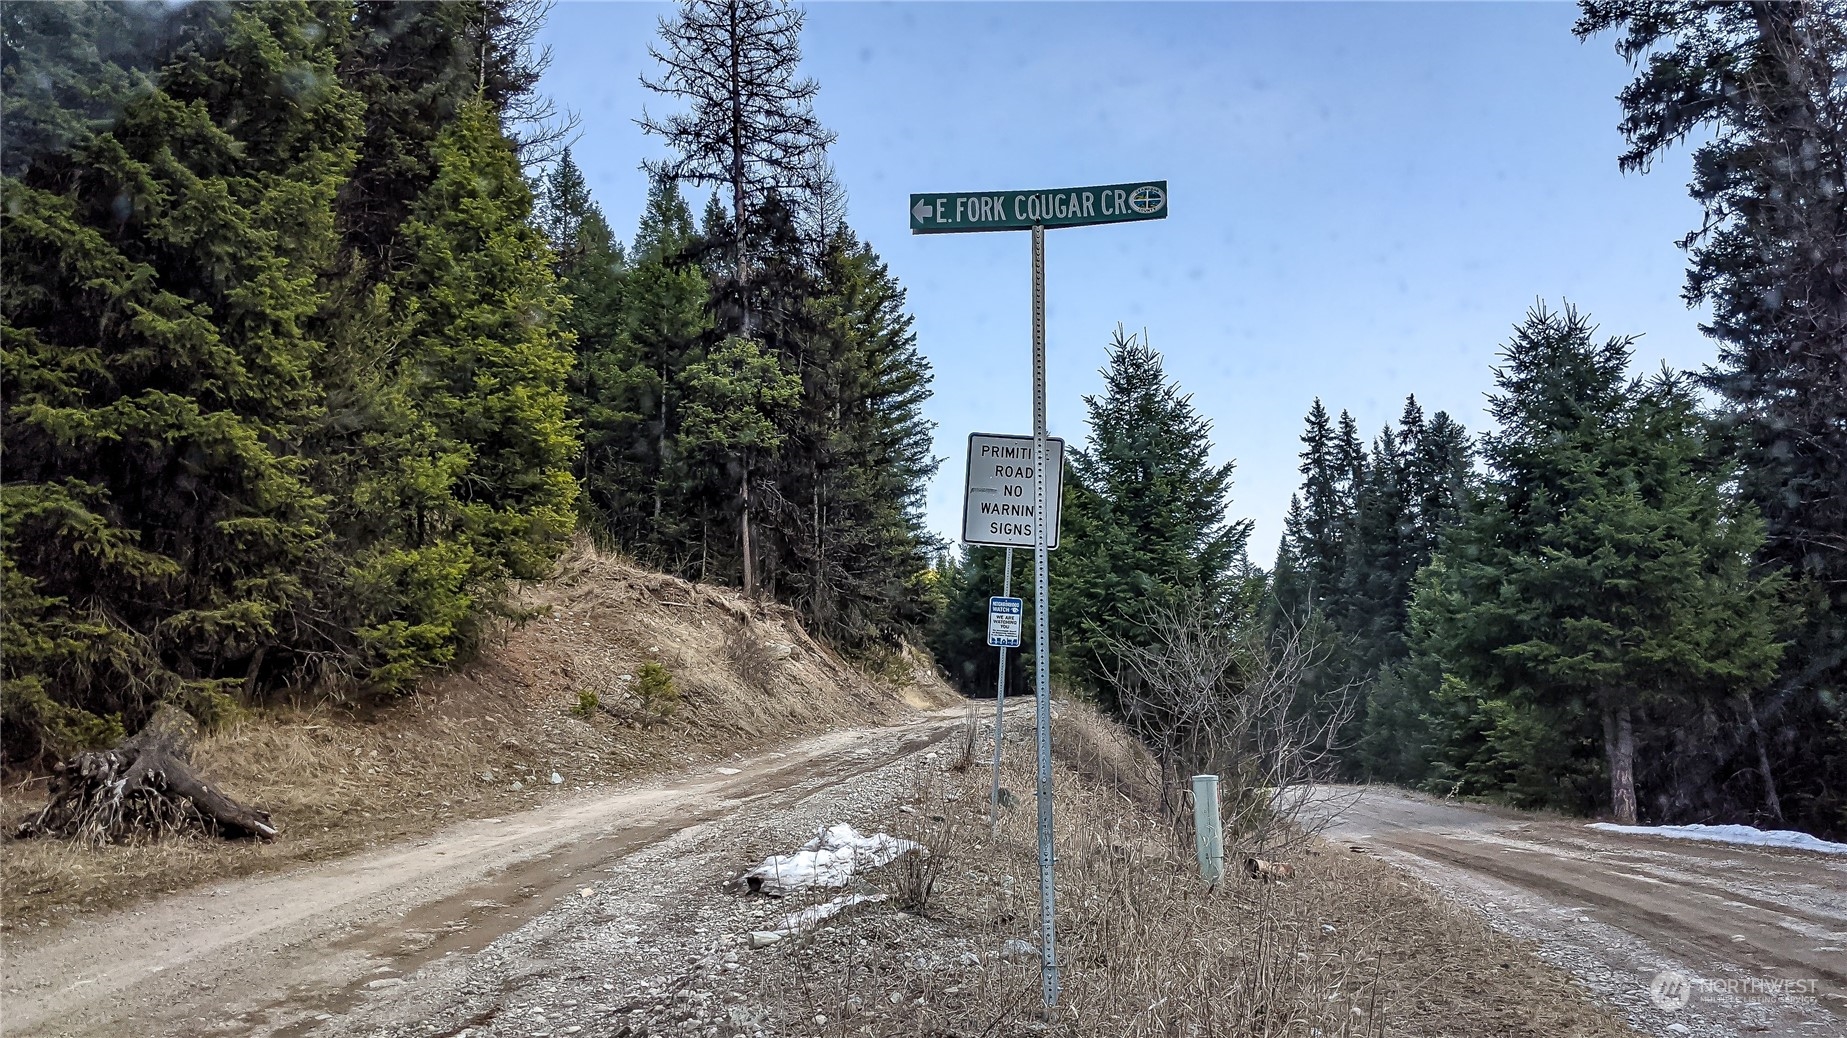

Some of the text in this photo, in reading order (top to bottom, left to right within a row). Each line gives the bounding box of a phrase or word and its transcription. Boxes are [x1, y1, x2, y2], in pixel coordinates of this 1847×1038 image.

[936, 189, 1132, 223] E. FORK COUGAR CR.
[982, 445, 1050, 461] PRIMITI
[995, 465, 1034, 479] ROAD
[1004, 485, 1023, 497] NO
[981, 502, 1034, 517] WARNIN
[990, 521, 1032, 536] SIGNS
